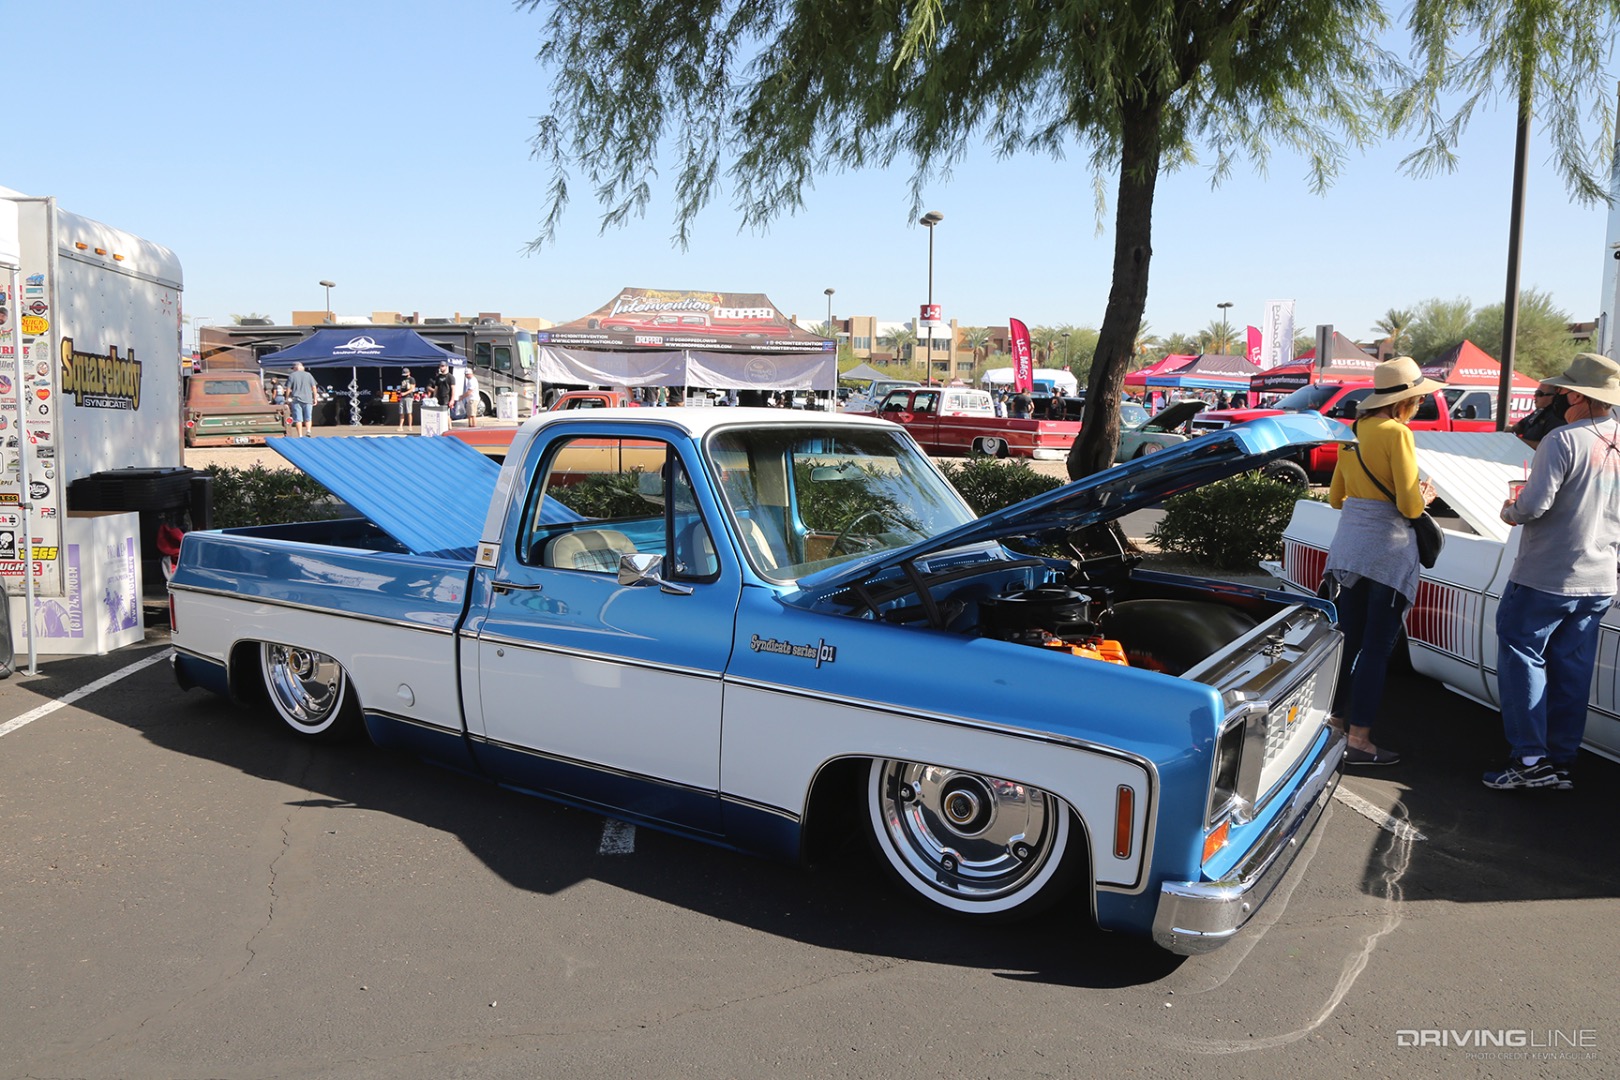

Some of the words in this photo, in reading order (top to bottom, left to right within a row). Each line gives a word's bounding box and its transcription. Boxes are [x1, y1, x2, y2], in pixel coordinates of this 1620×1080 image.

[609, 296, 713, 319] Intervention
[924, 307, 941, 319] J-2
[61, 336, 142, 411] Squarebody
[1018, 356, 1029, 381] MAGS
[85, 398, 127, 409] SYNDICATE
[750, 634, 791, 655] Syndicate
[792, 644, 817, 659] series
